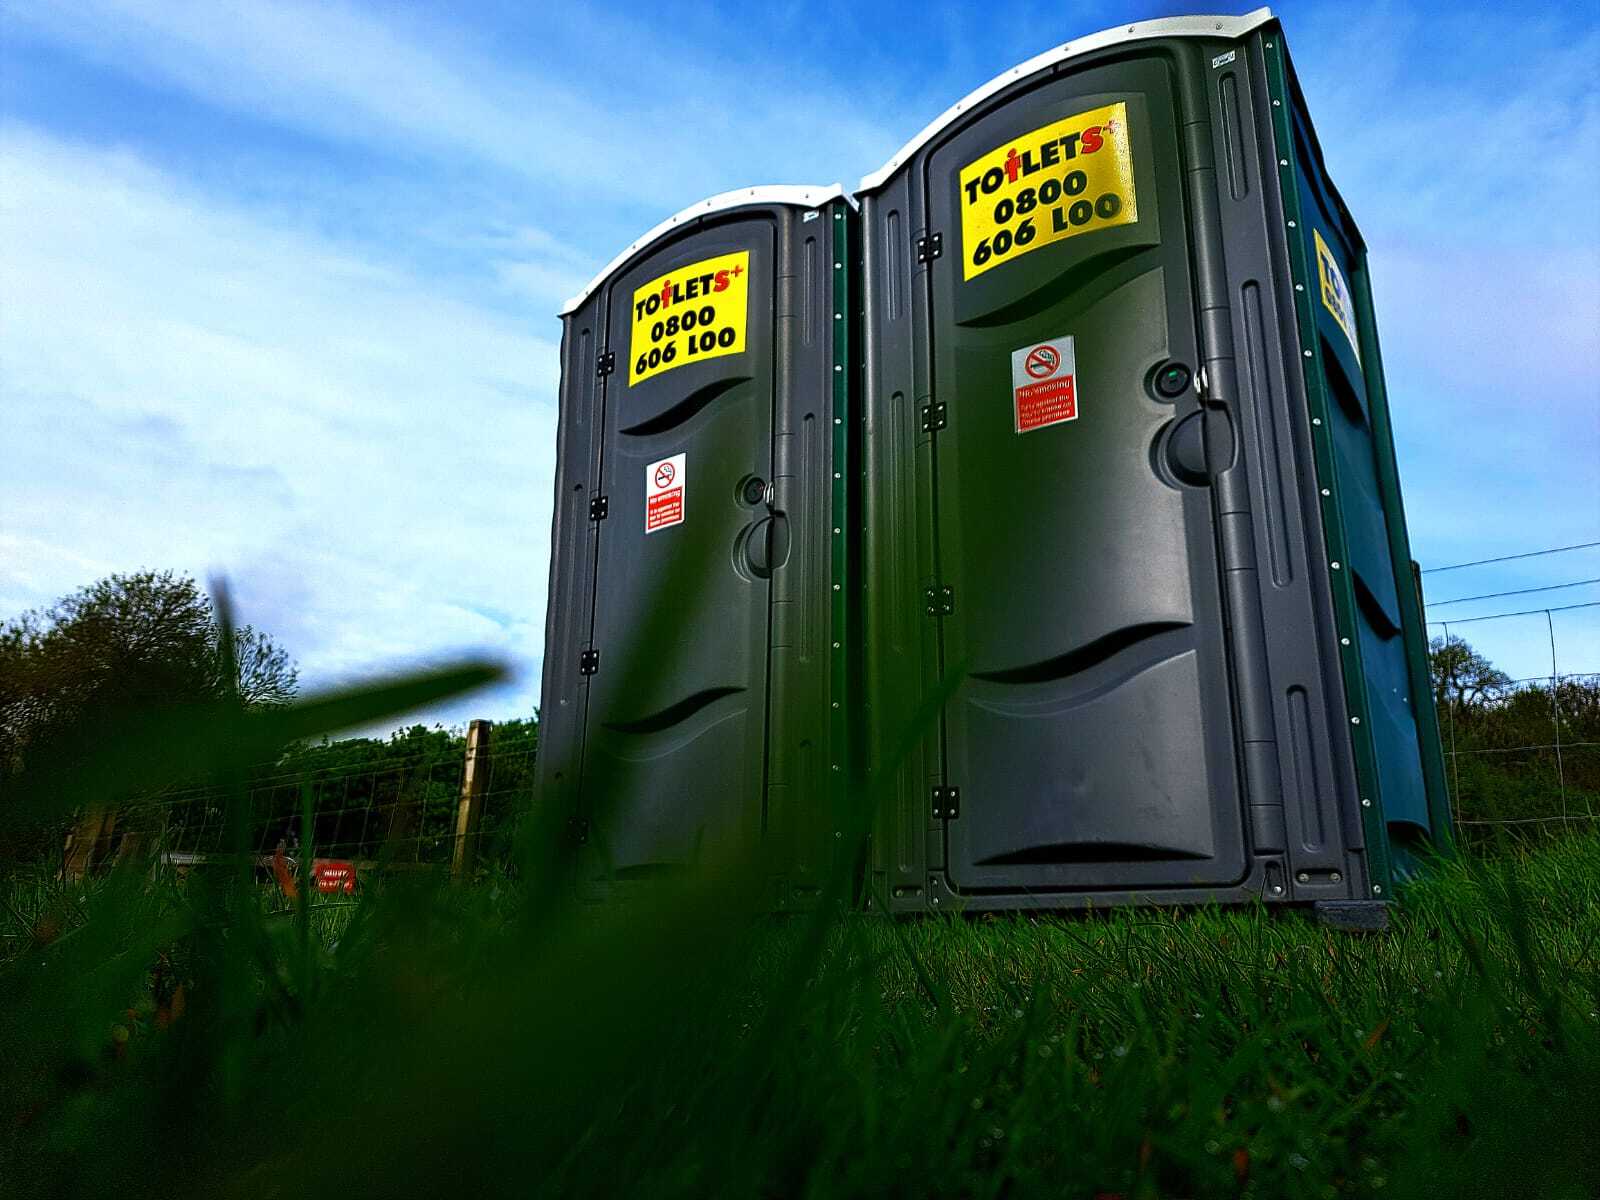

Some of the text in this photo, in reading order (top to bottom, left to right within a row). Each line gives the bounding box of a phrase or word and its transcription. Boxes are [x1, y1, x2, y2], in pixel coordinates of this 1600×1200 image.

[994, 169, 1087, 224] 0800
[973, 192, 1122, 266] 606 LOO
[651, 305, 715, 342] 0800
[635, 326, 736, 375] 606 LOO
